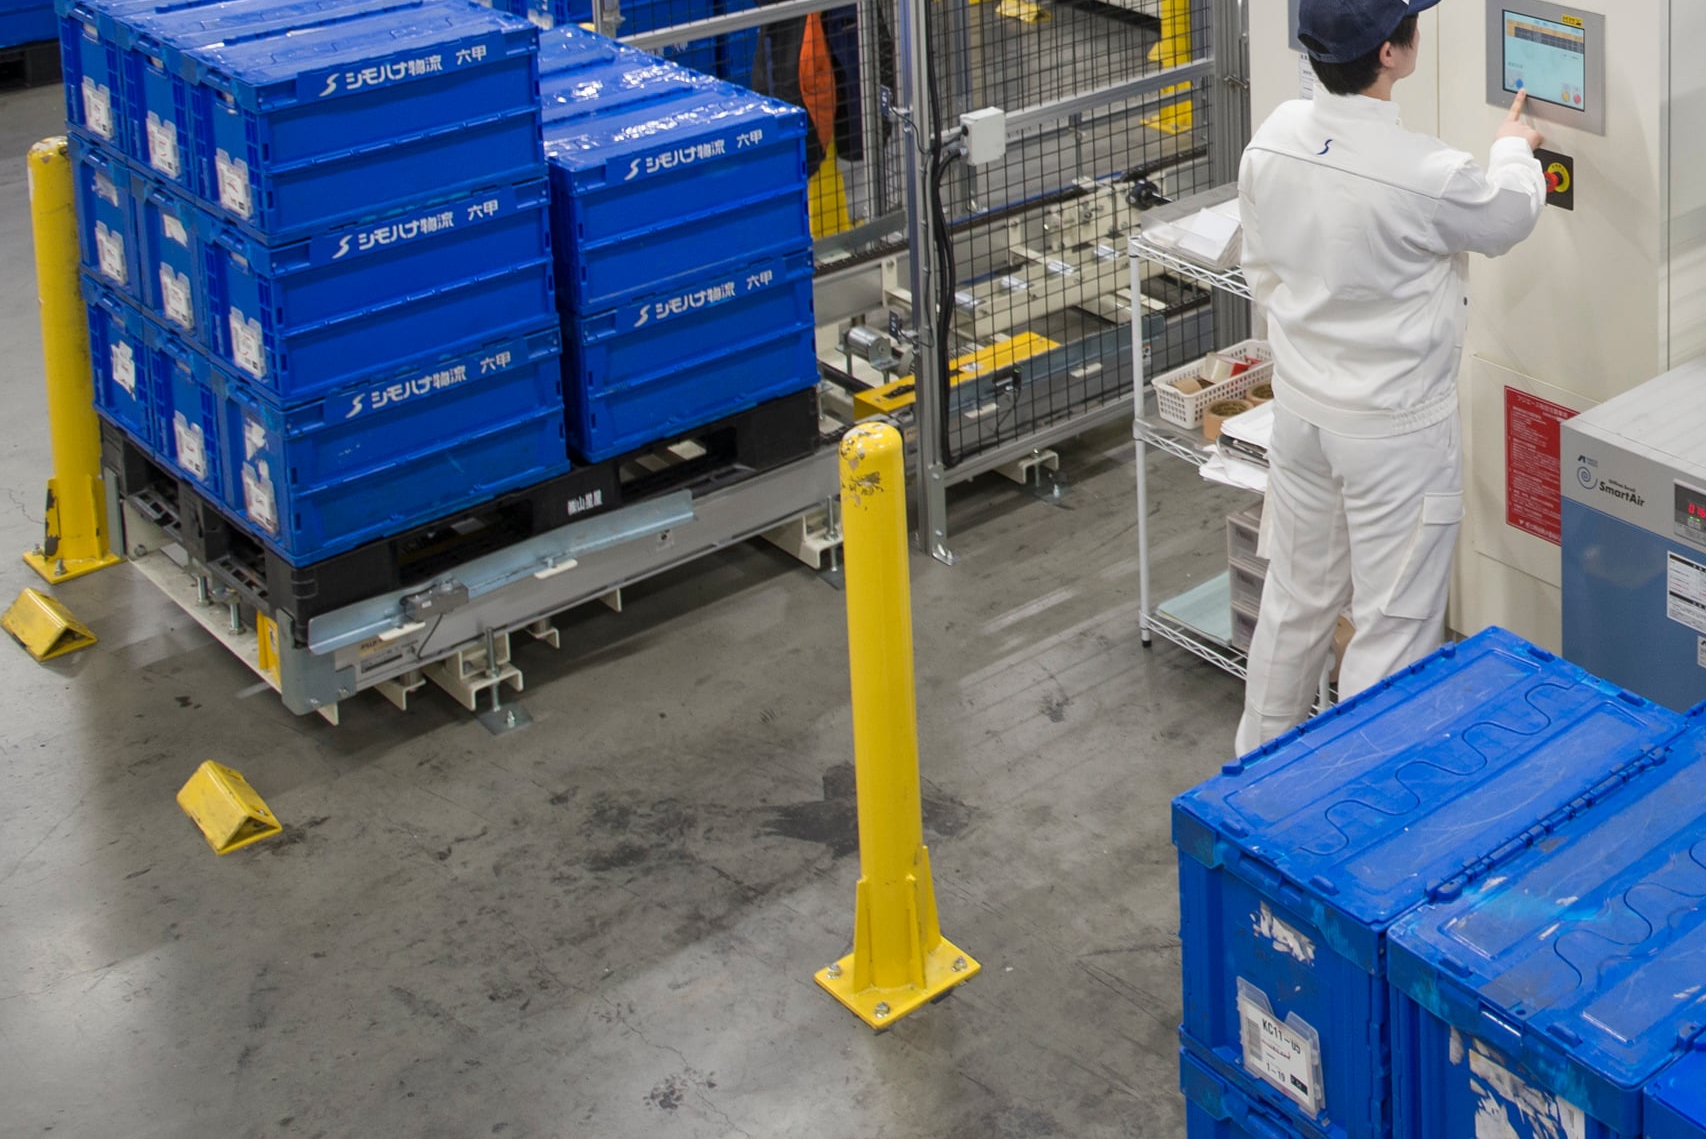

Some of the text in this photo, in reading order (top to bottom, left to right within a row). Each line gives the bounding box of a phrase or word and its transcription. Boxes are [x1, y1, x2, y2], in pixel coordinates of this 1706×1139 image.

[346, 45, 487, 89] シモハナ物流 六甲
[646, 129, 763, 173] シモハナ物流 六甲
[358, 199, 499, 250] シモハナ物流 六甲
[655, 269, 773, 319] シモハナ物流 六甲
[371, 351, 511, 408] シモハナ物流 六甲
[1599, 481, 1645, 507] SmartAir
